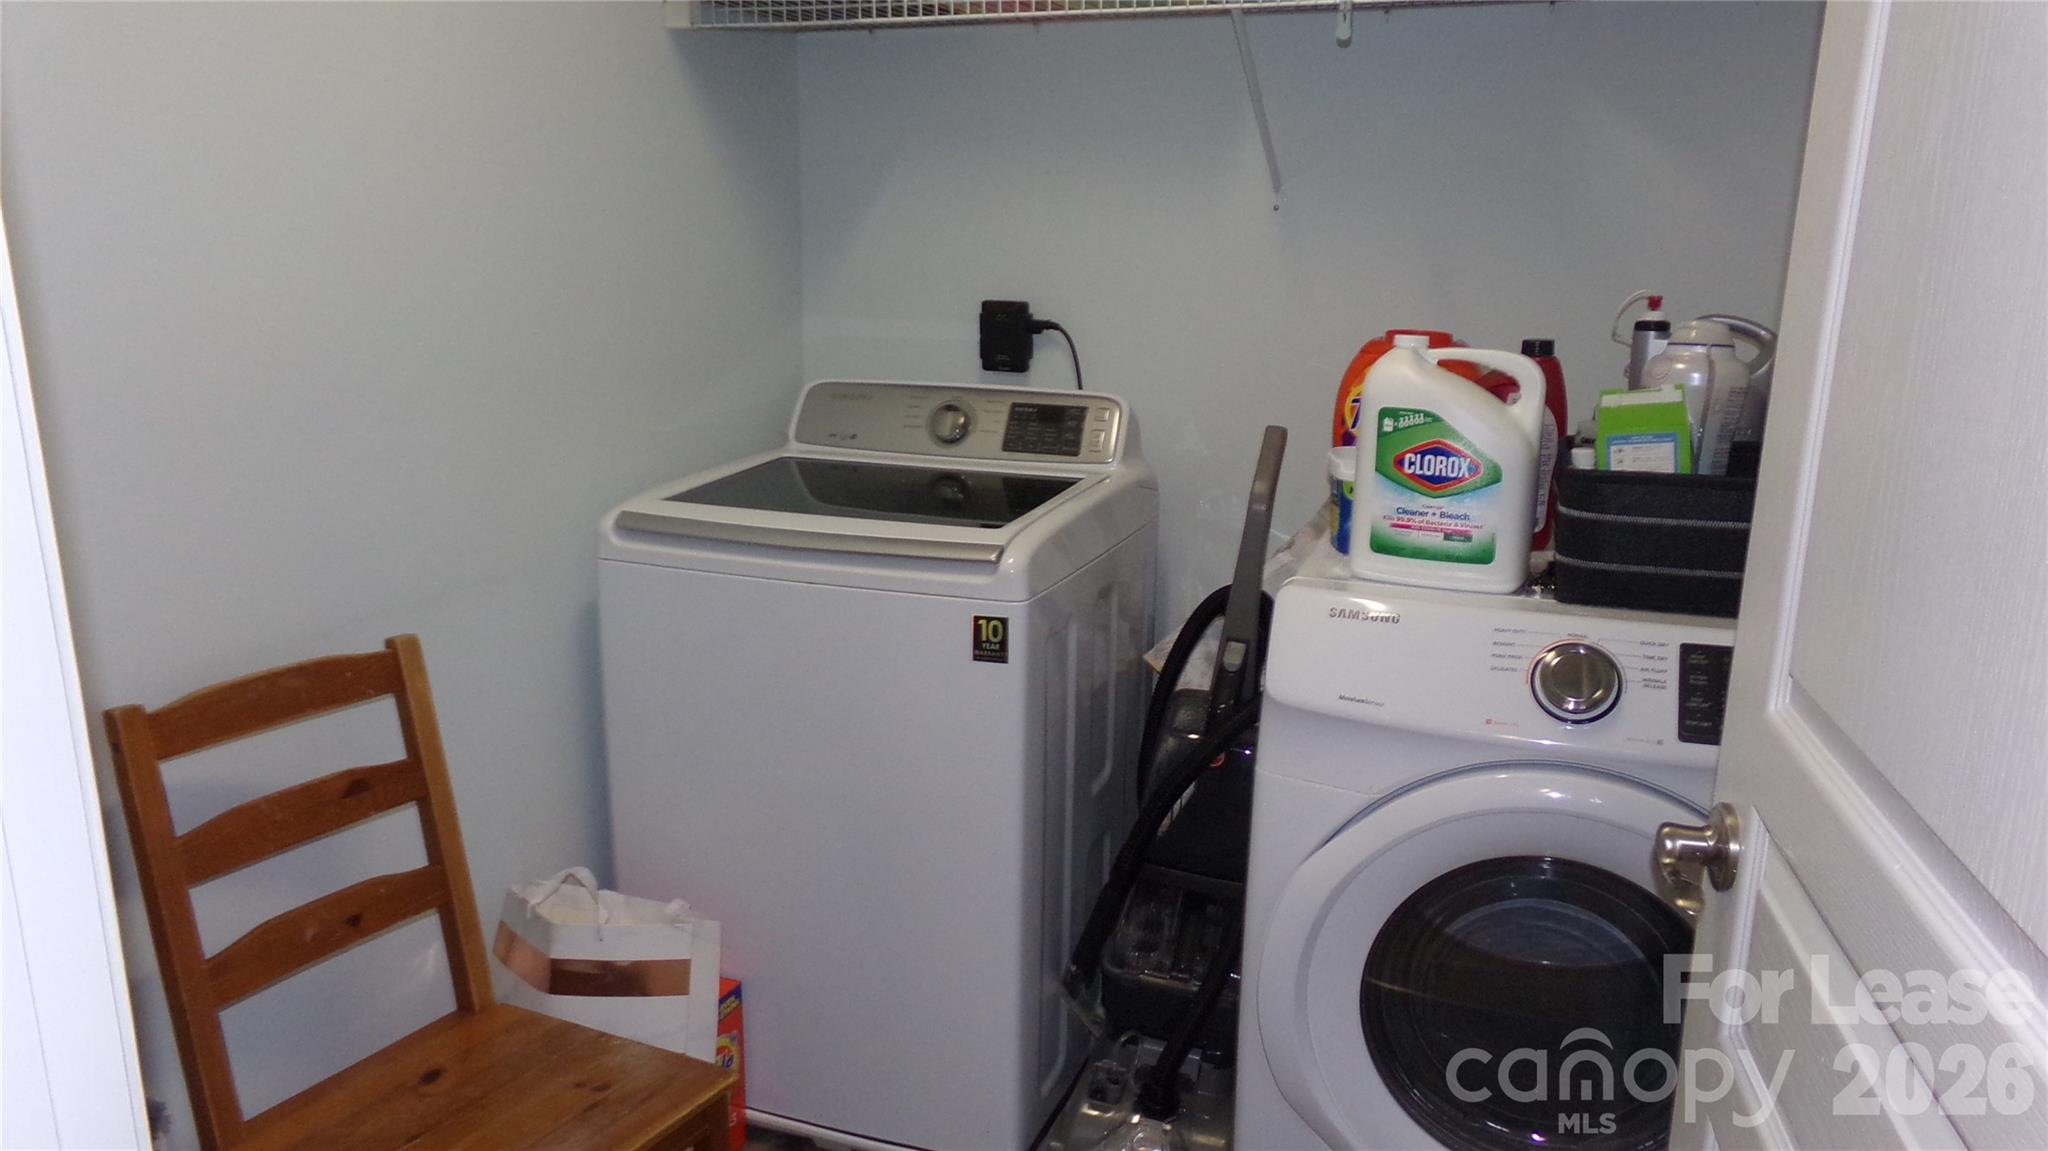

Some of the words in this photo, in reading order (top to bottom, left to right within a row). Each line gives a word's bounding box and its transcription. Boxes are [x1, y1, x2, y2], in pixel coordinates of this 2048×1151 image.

[1403, 453, 1471, 478] CLOROX
[1396, 507, 1429, 517] Cleaner
[1440, 510, 1470, 521] Bleach
[1329, 607, 1400, 624] SAMSUNG
[977, 619, 1003, 643] 10
